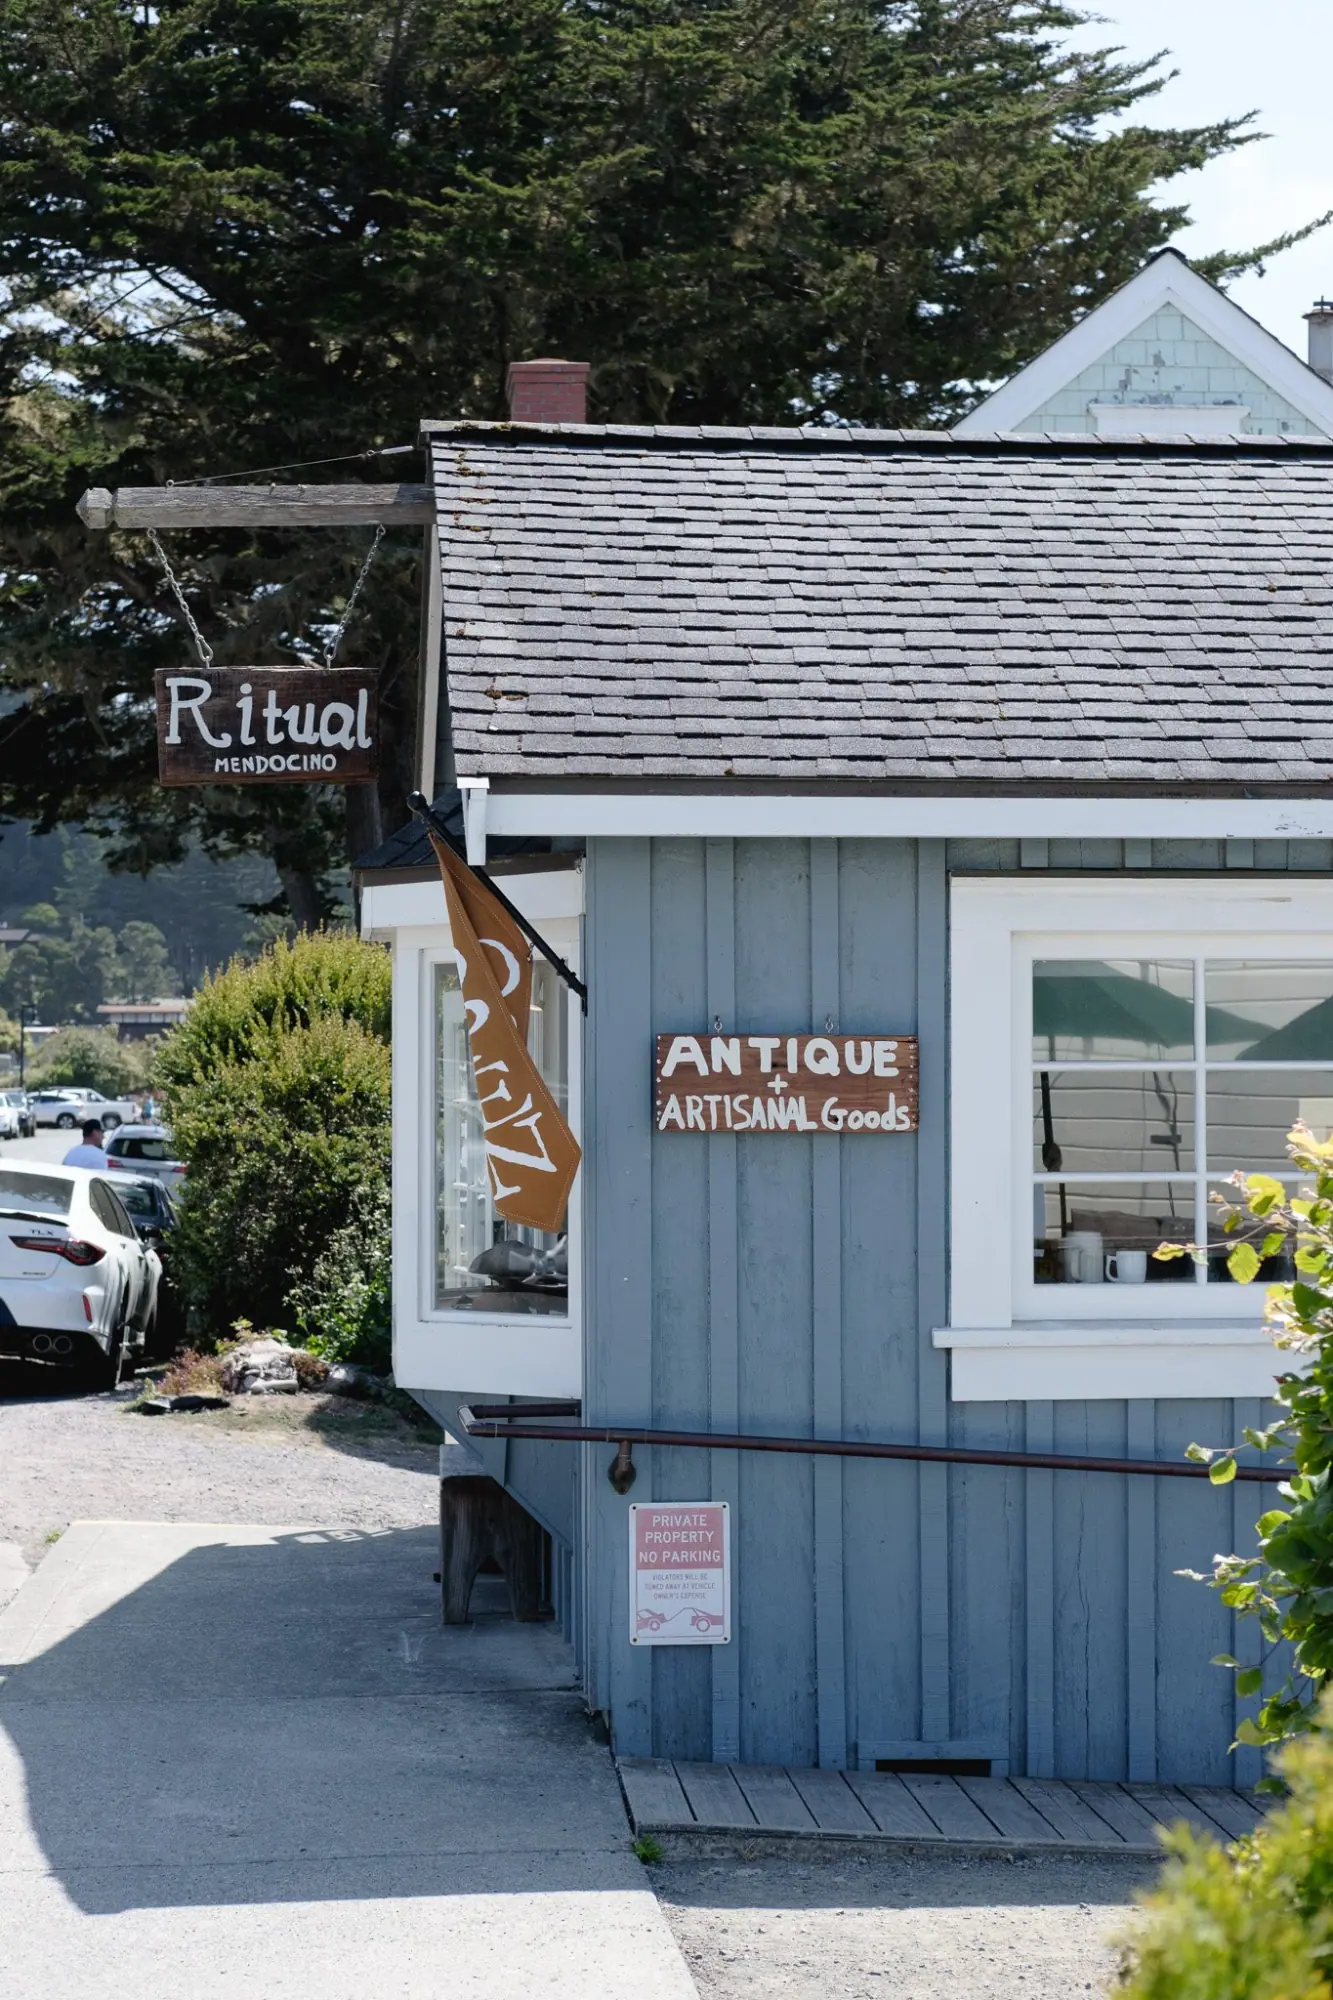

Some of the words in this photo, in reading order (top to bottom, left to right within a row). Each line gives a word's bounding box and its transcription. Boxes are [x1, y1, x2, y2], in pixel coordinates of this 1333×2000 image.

[164, 676, 373, 750] Ritual
[214, 753, 338, 774] MENDOCINO
[660, 1035, 900, 1077] ANTIQUE
[766, 1073, 789, 1095] +
[658, 1093, 818, 1132] ARTISANAL
[821, 1091, 911, 1132] Goods
[652, 1514, 708, 1527] PRIVATE
[645, 1530, 715, 1544] PROPERTY
[639, 1551, 658, 1563] NO
[662, 1550, 721, 1563] PARKING
[652, 1573, 684, 1581] VIOLATORS
[690, 1582, 716, 1590] VEHICLE
